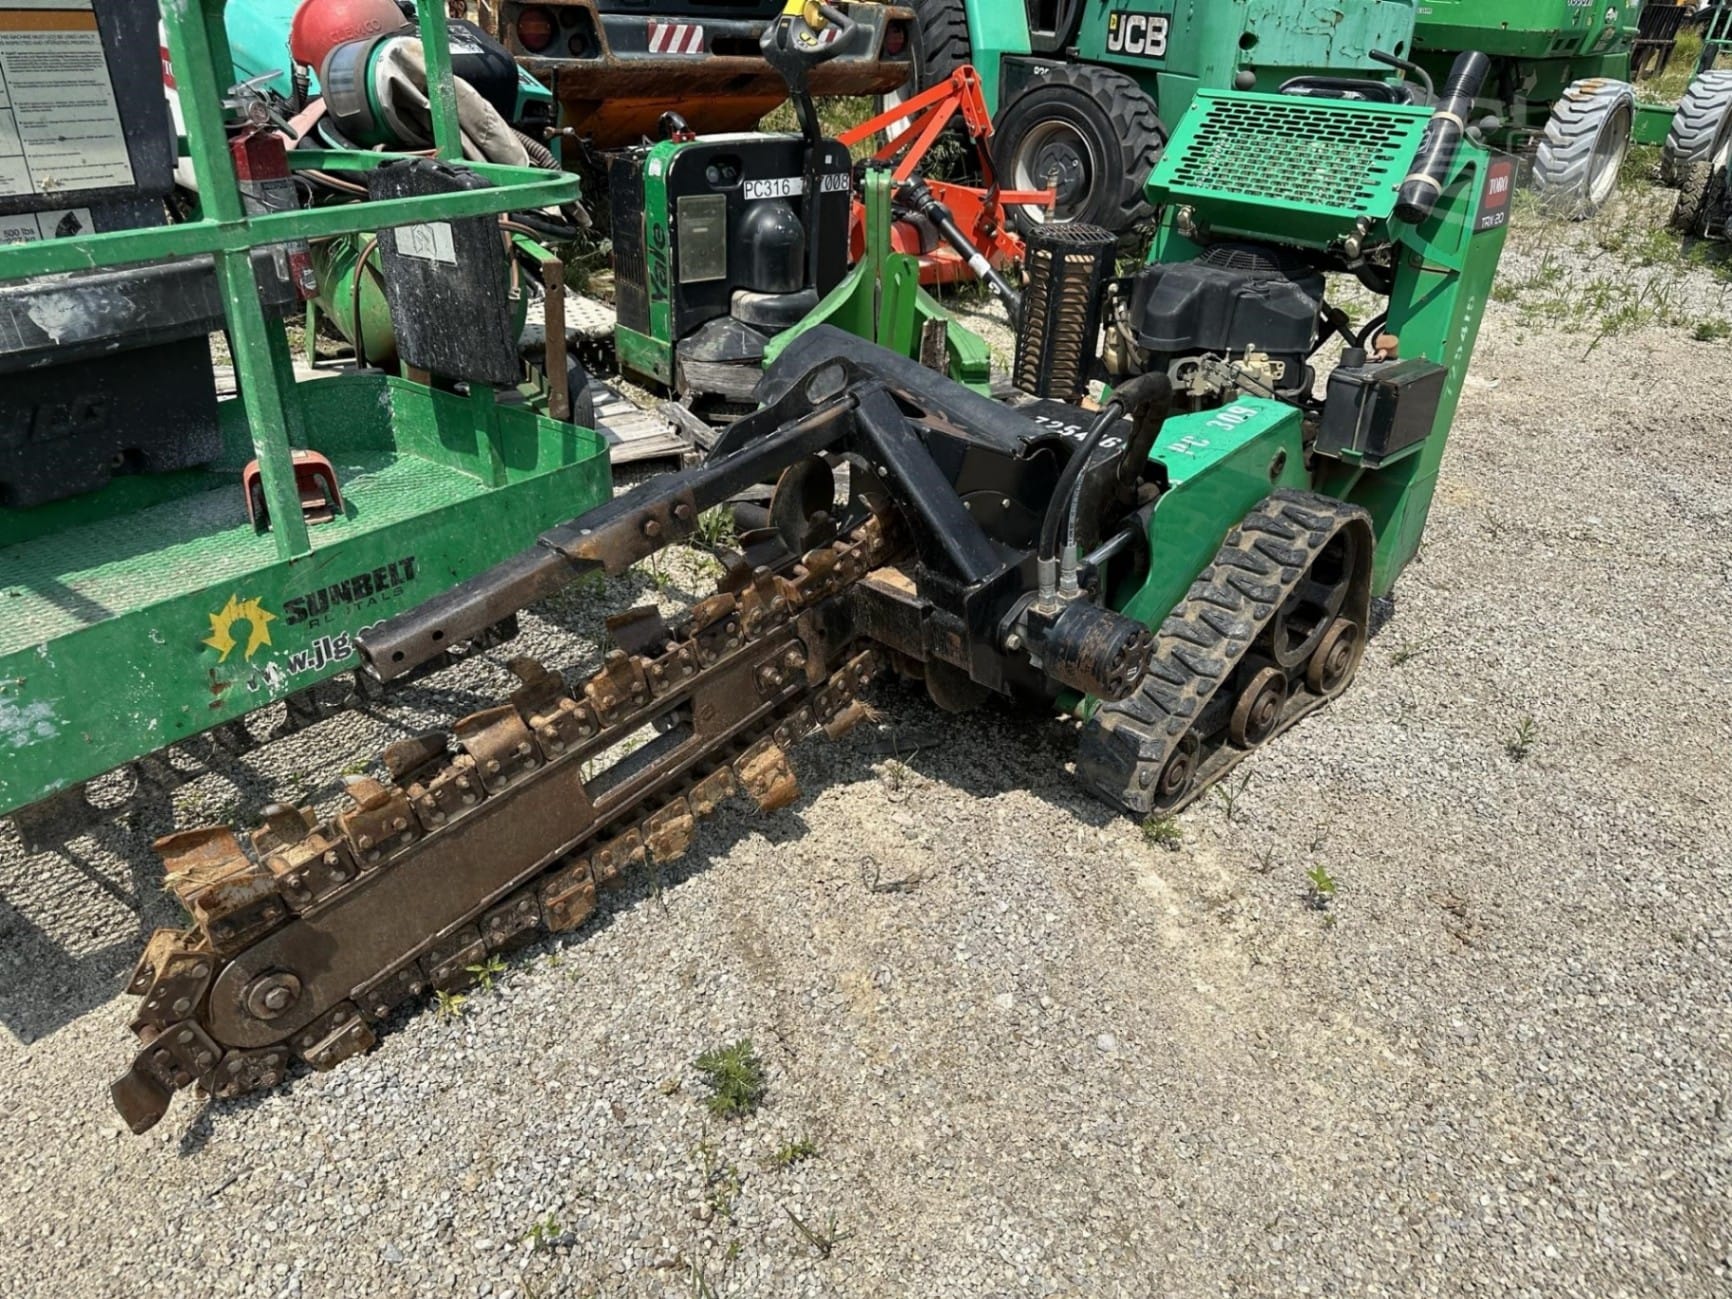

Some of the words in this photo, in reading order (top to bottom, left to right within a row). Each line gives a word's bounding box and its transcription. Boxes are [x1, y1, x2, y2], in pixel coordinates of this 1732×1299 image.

[329, 18, 382, 42] CLEMCO
[1108, 14, 1168, 56] JCB
[744, 179, 790, 198] PC316
[1489, 176, 1508, 195] TORO
[648, 222, 668, 302] Yale
[1034, 415, 1122, 448] 72546
[1168, 435, 1210, 455] PC
[1206, 406, 1258, 431] 309
[283, 556, 415, 625] SUNBELT
[309, 586, 404, 629] RTALS
